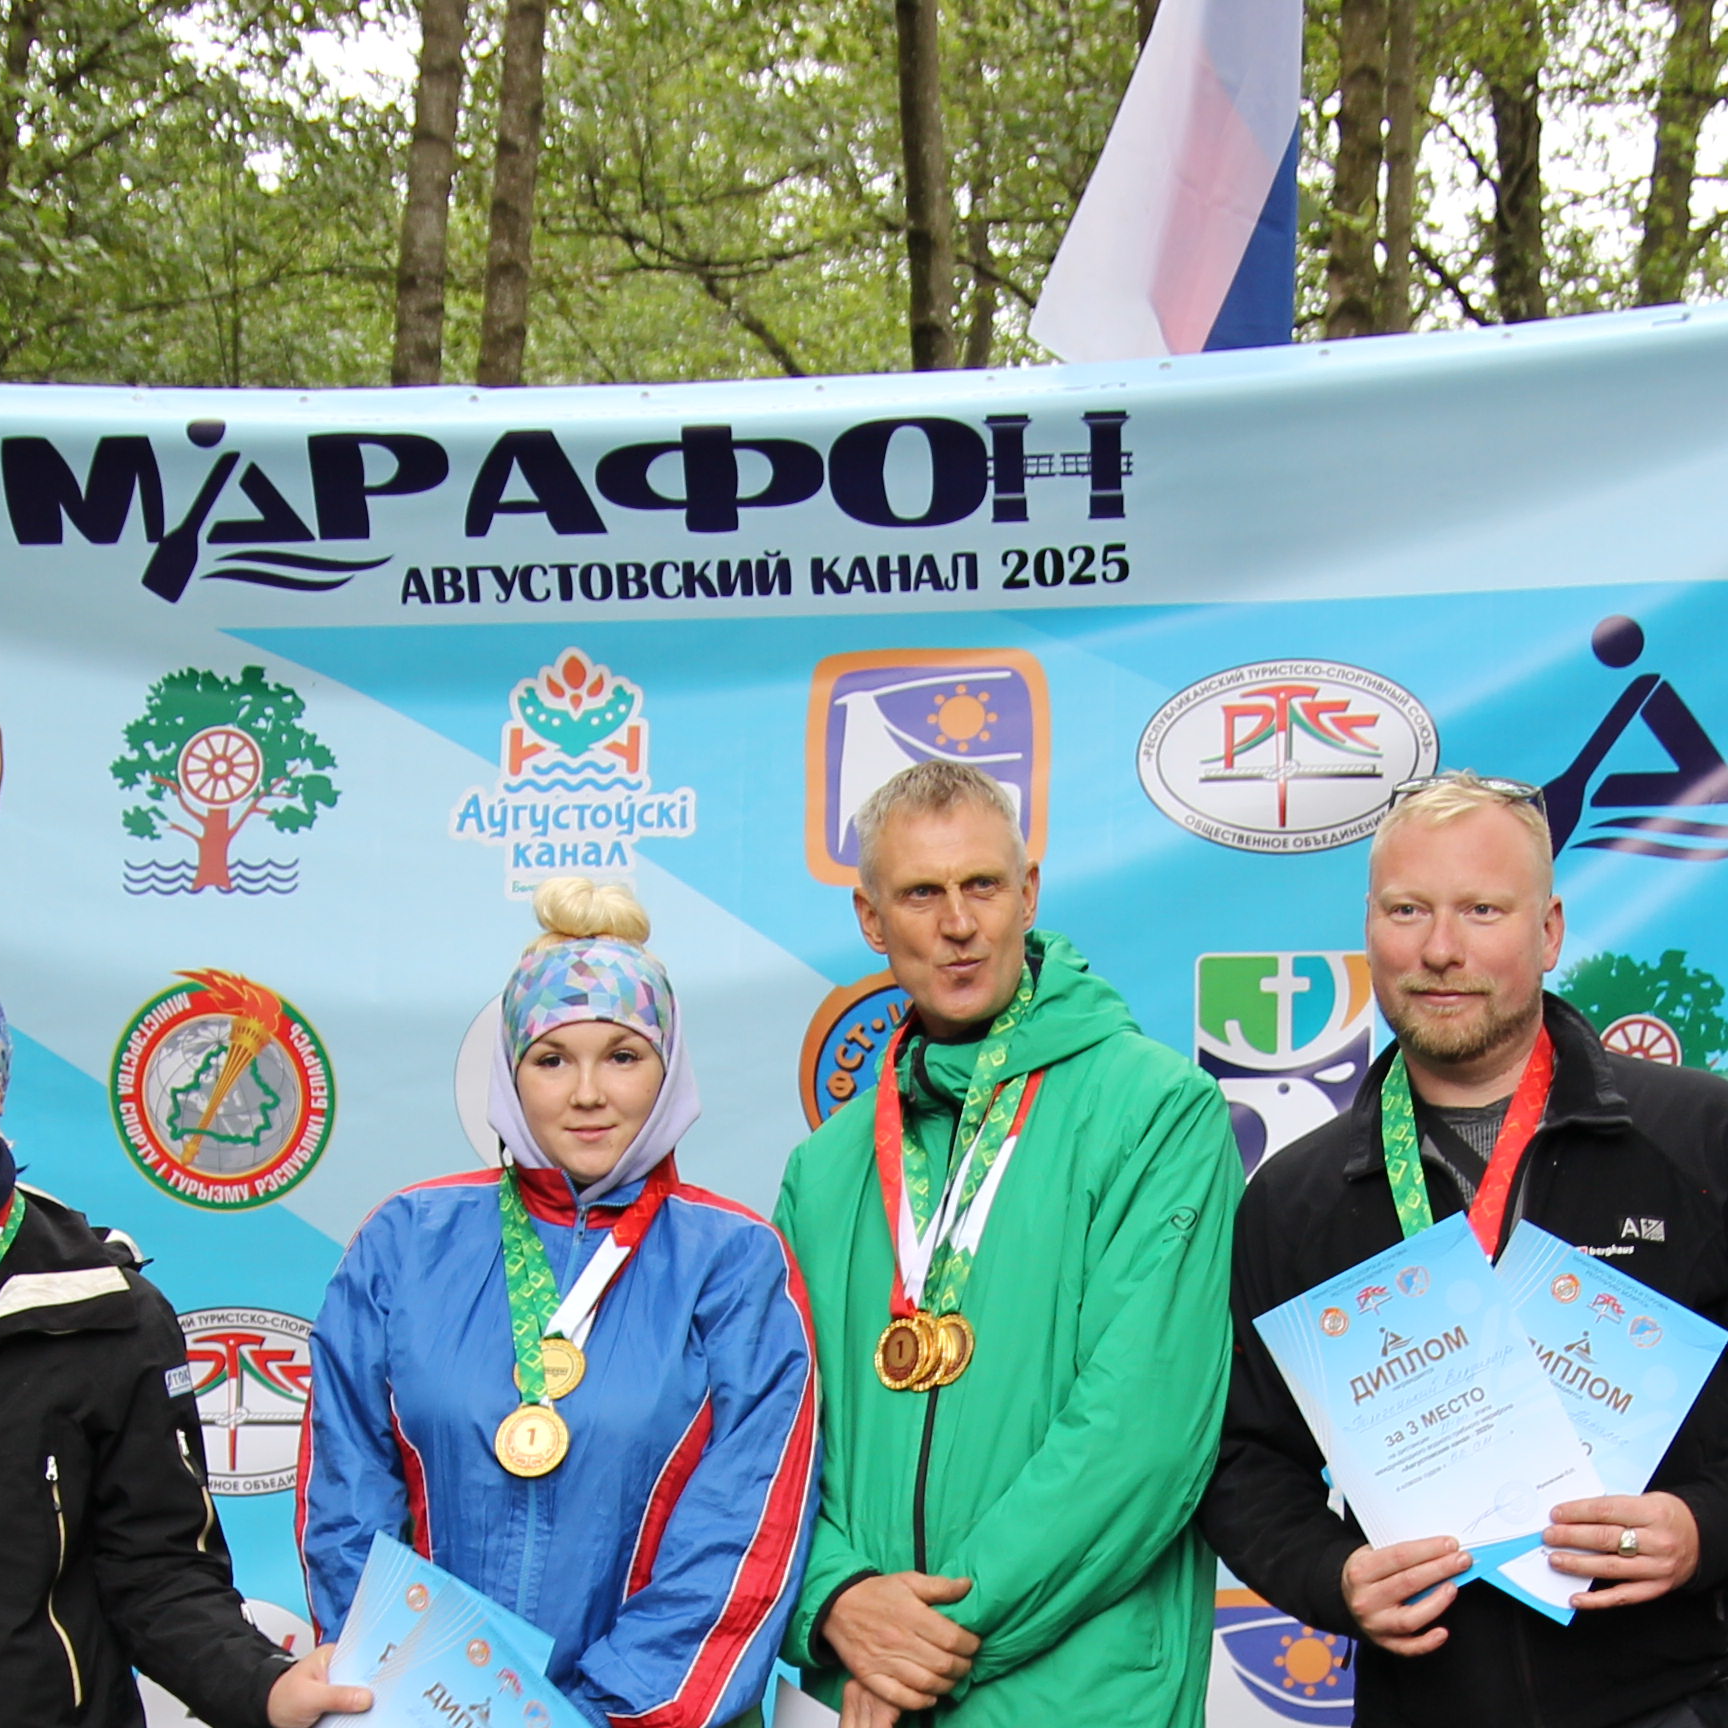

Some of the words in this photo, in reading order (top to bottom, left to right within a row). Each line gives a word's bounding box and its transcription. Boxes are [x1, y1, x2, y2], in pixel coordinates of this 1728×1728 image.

[1, 411, 1133, 603] МАРАФОН
[402, 549, 792, 605] АВГУСТОВСКИЙ
[809, 552, 978, 594] КАНАЛ
[1001, 543, 1130, 590] 2025
[1248, 664, 1411, 708] ТУРИСТСКО-СПОРТИВНЫЙ
[511, 841, 628, 868] канал
[1184, 814, 1290, 850] ОБЩЕСТВЕННОЕ
[117, 991, 192, 1096] МІНІСТЭРСТВА
[288, 1022, 329, 1110] БЕЛАРУСЬ
[826, 1022, 875, 1114] ФСТ
[118, 1101, 161, 1164] СПОРТУ
[254, 1113, 326, 1198] РЭСПУБЛІКІ
[167, 1168, 251, 1205] ТУРЫЗМУ
[1588, 1244, 1635, 1257] berghaus
[197, 1312, 310, 1336] ТУРИСТСКО-СПОРТ
[896, 1340, 905, 1360] 1
[1349, 1325, 1470, 1406] ДИПЛОМ
[1534, 1344, 1634, 1416] ИПЛОМ
[527, 1427, 537, 1447] 1
[1384, 1429, 1405, 1448] за
[1406, 1420, 1420, 1436] 3
[1420, 1386, 1486, 1429] МЕСТО
[242, 1474, 297, 1492] ОБЪЕДИ
